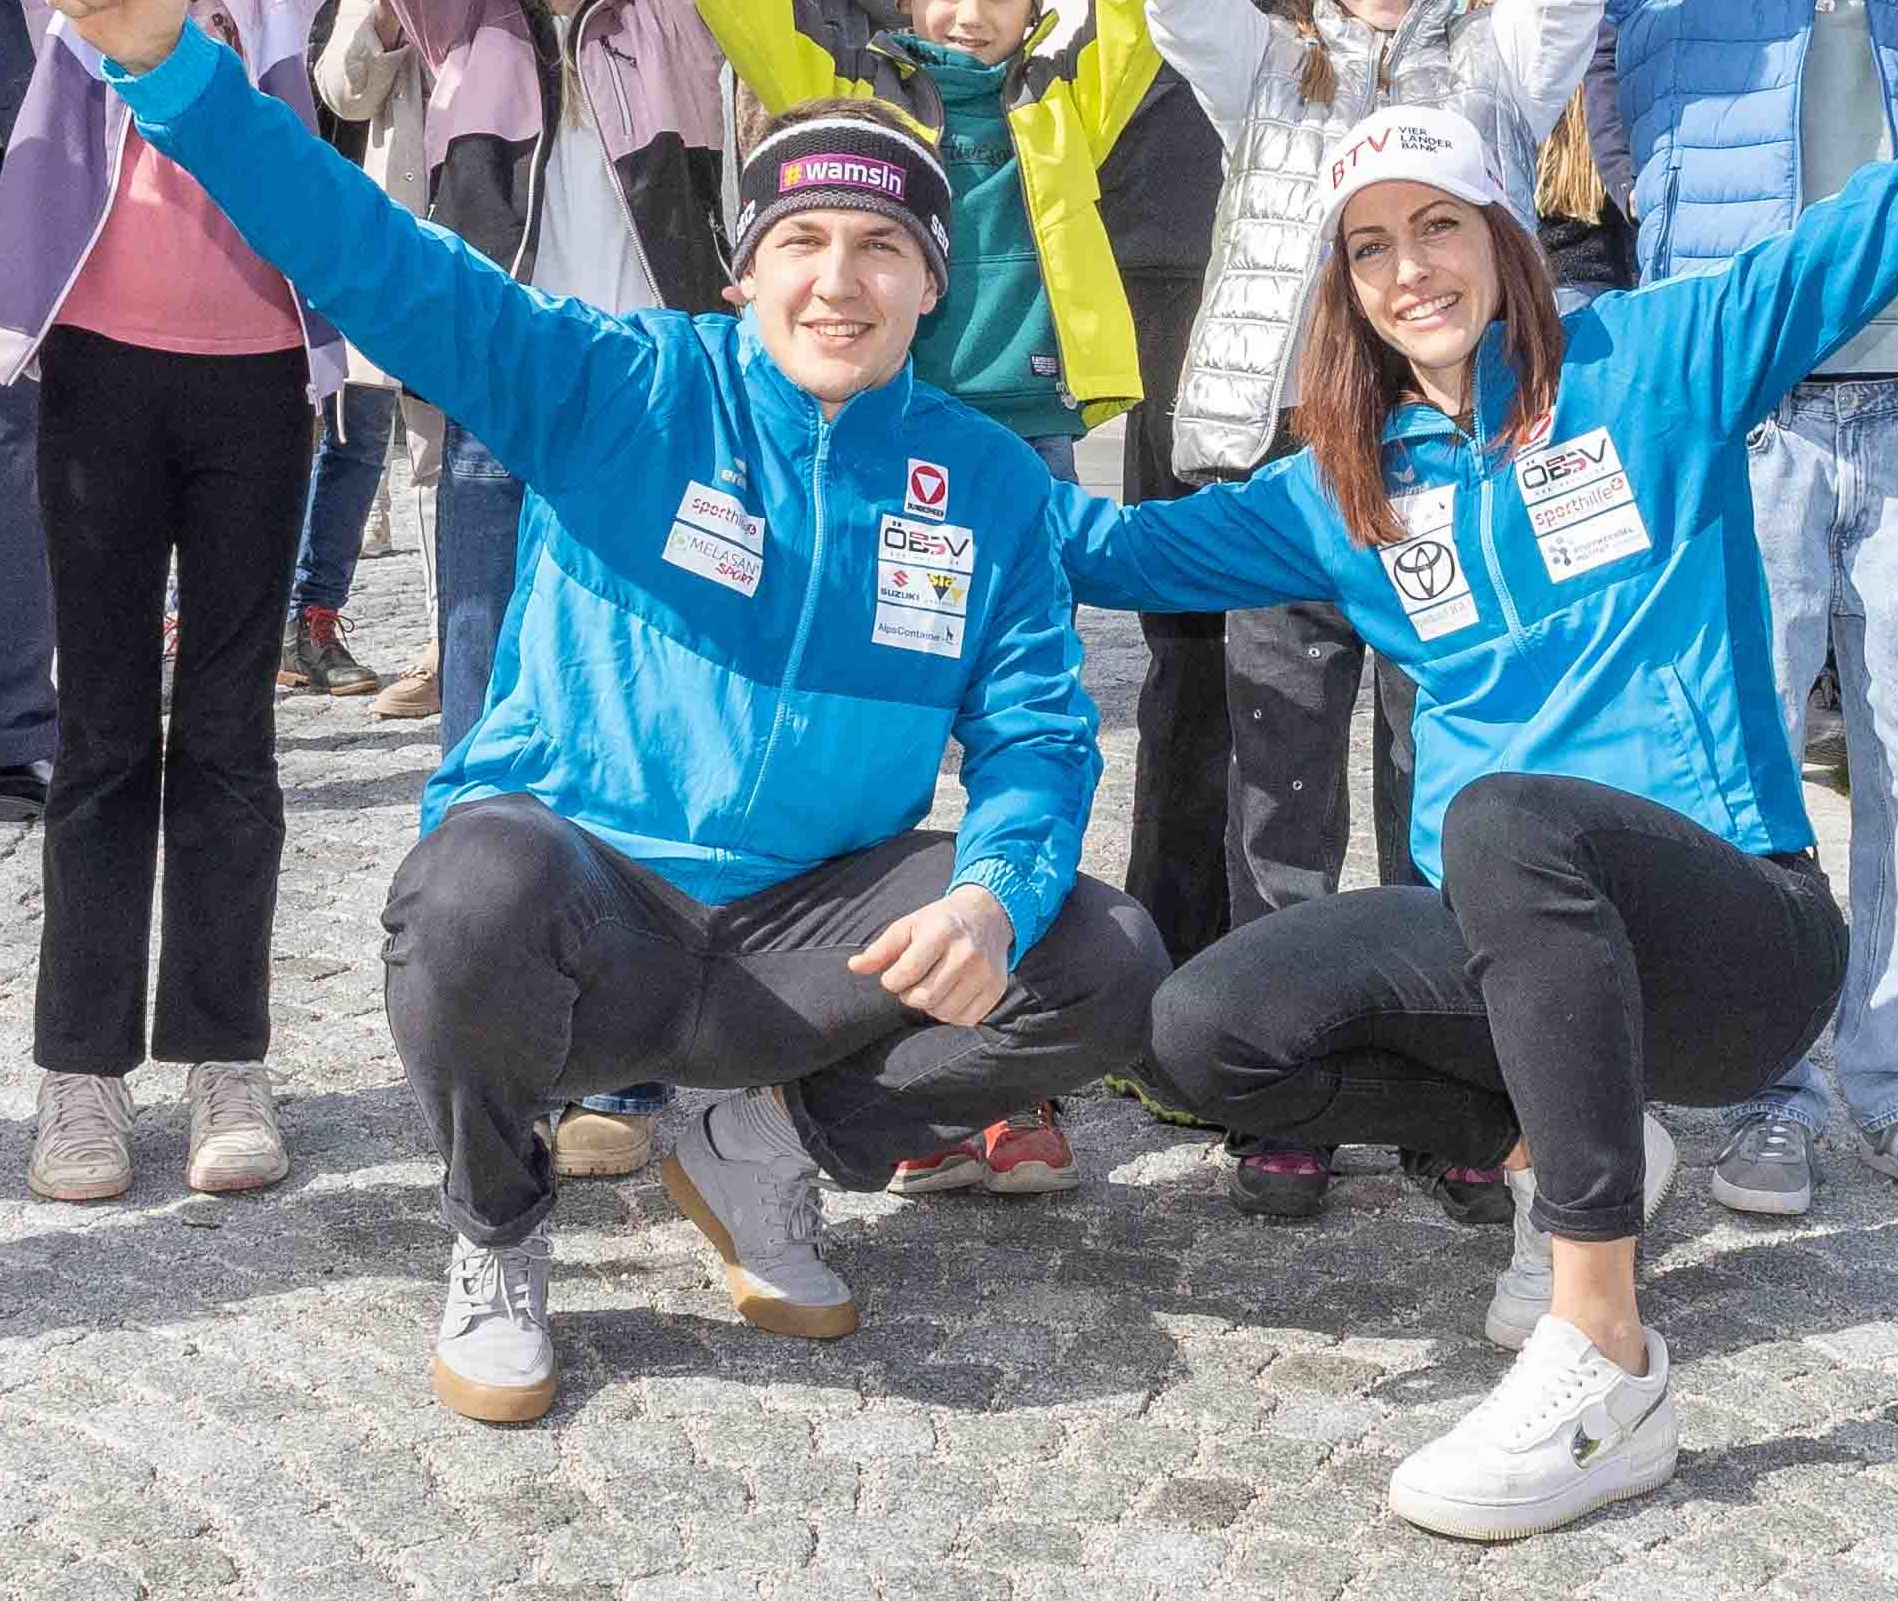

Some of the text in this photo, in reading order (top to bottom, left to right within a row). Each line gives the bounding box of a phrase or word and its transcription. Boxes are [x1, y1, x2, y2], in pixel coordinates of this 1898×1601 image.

[1398, 126, 1428, 136] VIER
[1401, 143, 1438, 154] BANK
[1332, 127, 1392, 190] BTV
[880, 588, 920, 601] SUZUKI
